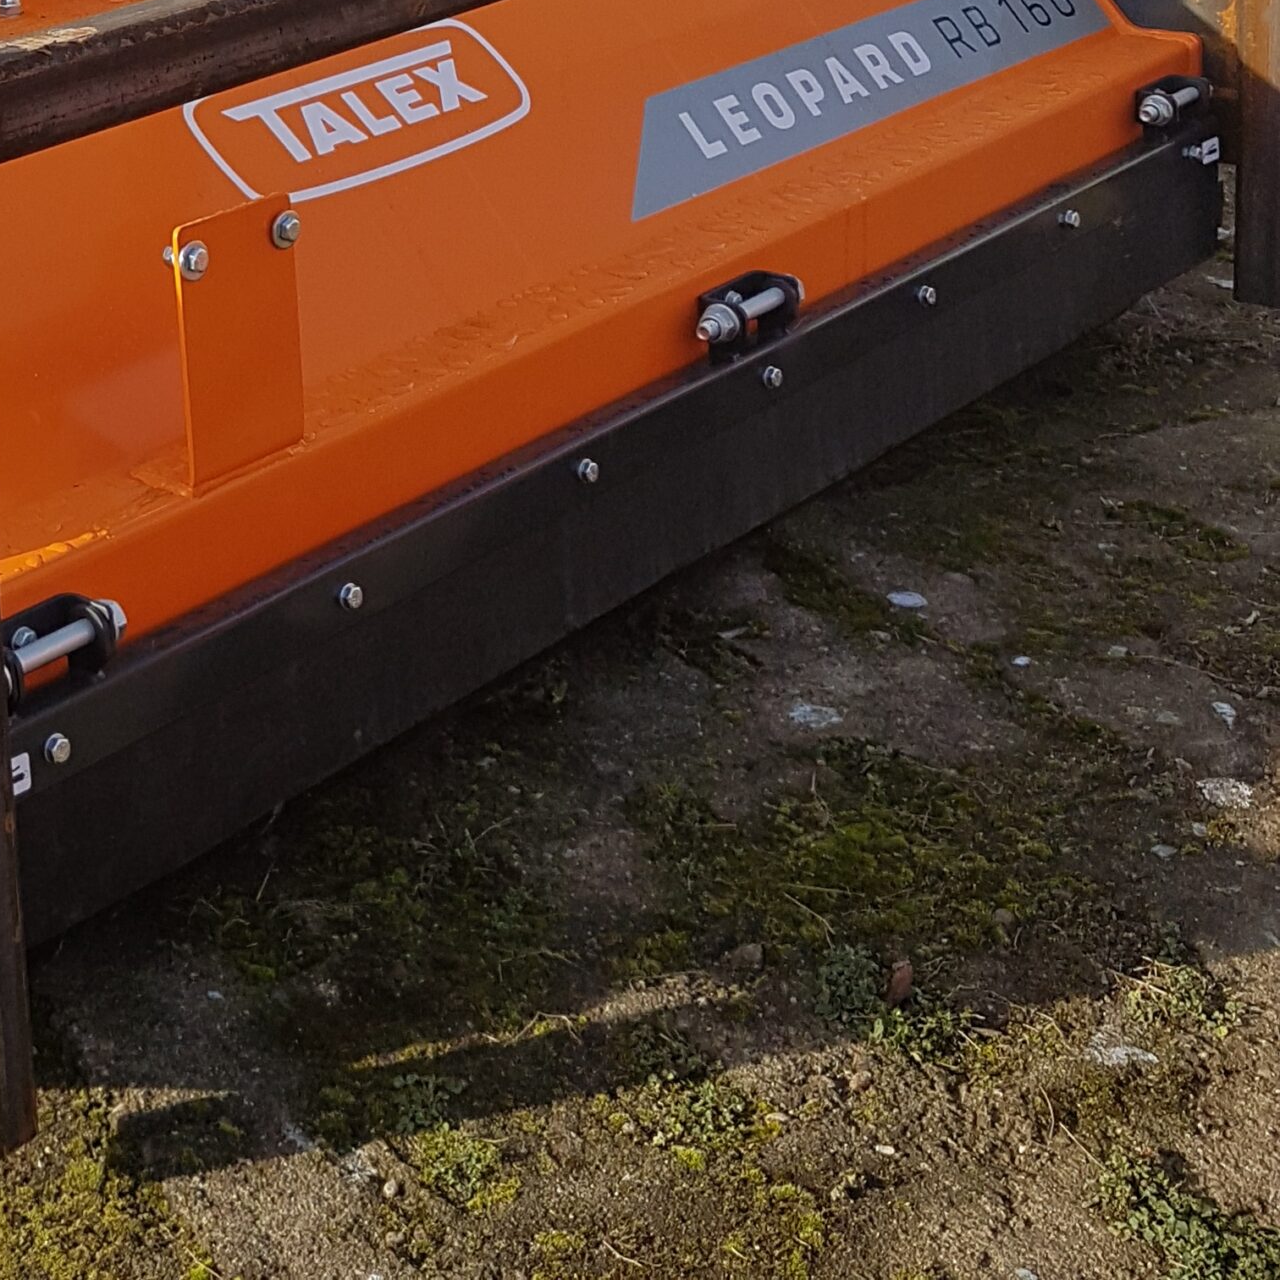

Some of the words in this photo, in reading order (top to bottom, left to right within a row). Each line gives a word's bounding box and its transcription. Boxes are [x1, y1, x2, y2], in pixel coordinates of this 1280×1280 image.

[221, 40, 488, 163] TALEX
[678, 31, 932, 159] LEOPARD
[932, 6, 1001, 59] RB
